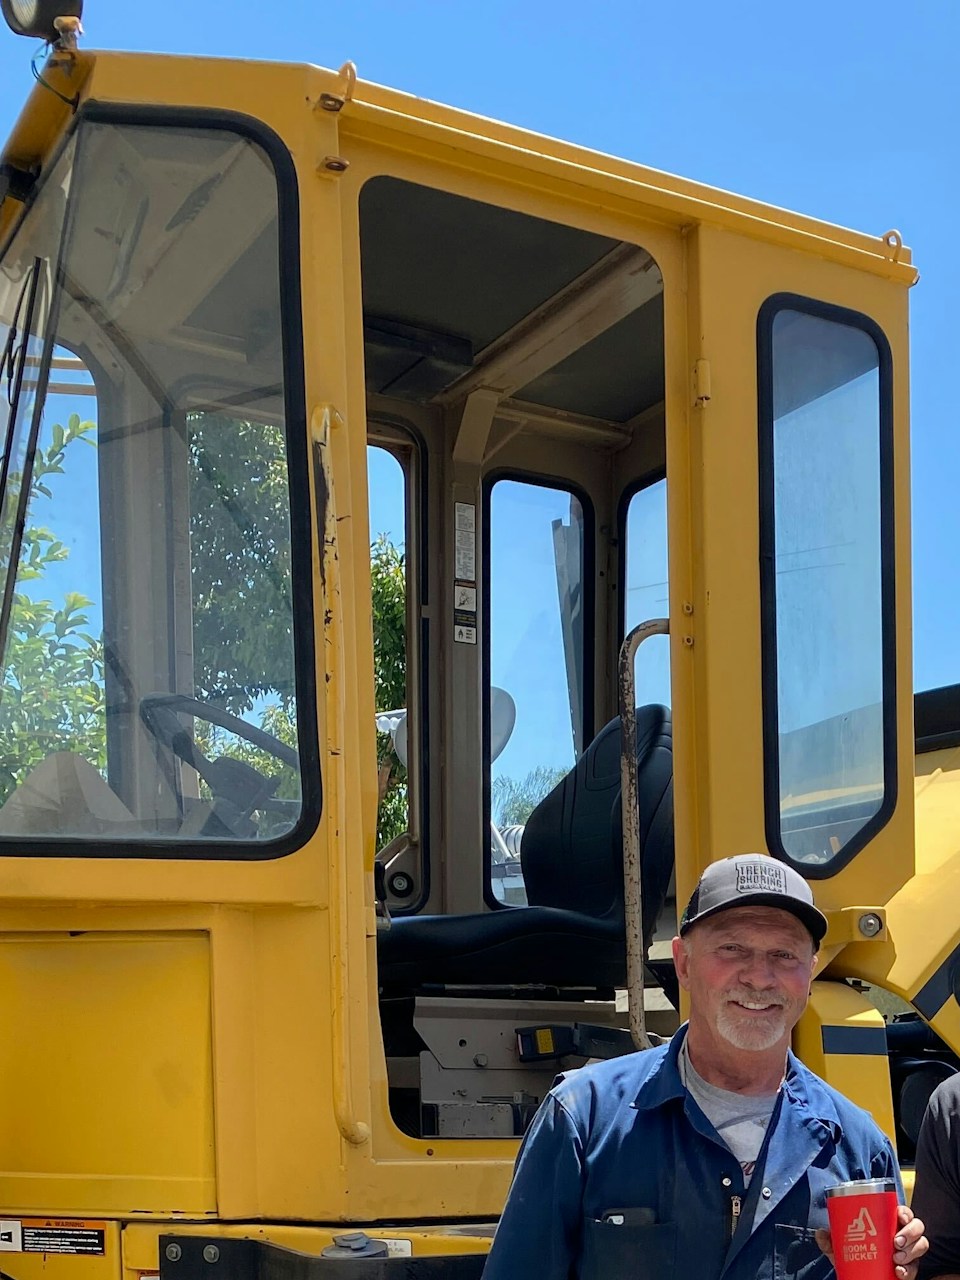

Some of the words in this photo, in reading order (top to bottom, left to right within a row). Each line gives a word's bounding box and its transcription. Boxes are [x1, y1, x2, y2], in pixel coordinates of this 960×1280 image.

[740, 865, 781, 880] TRENCH
[740, 875, 782, 888] SHORING
[870, 1243, 877, 1251] &
